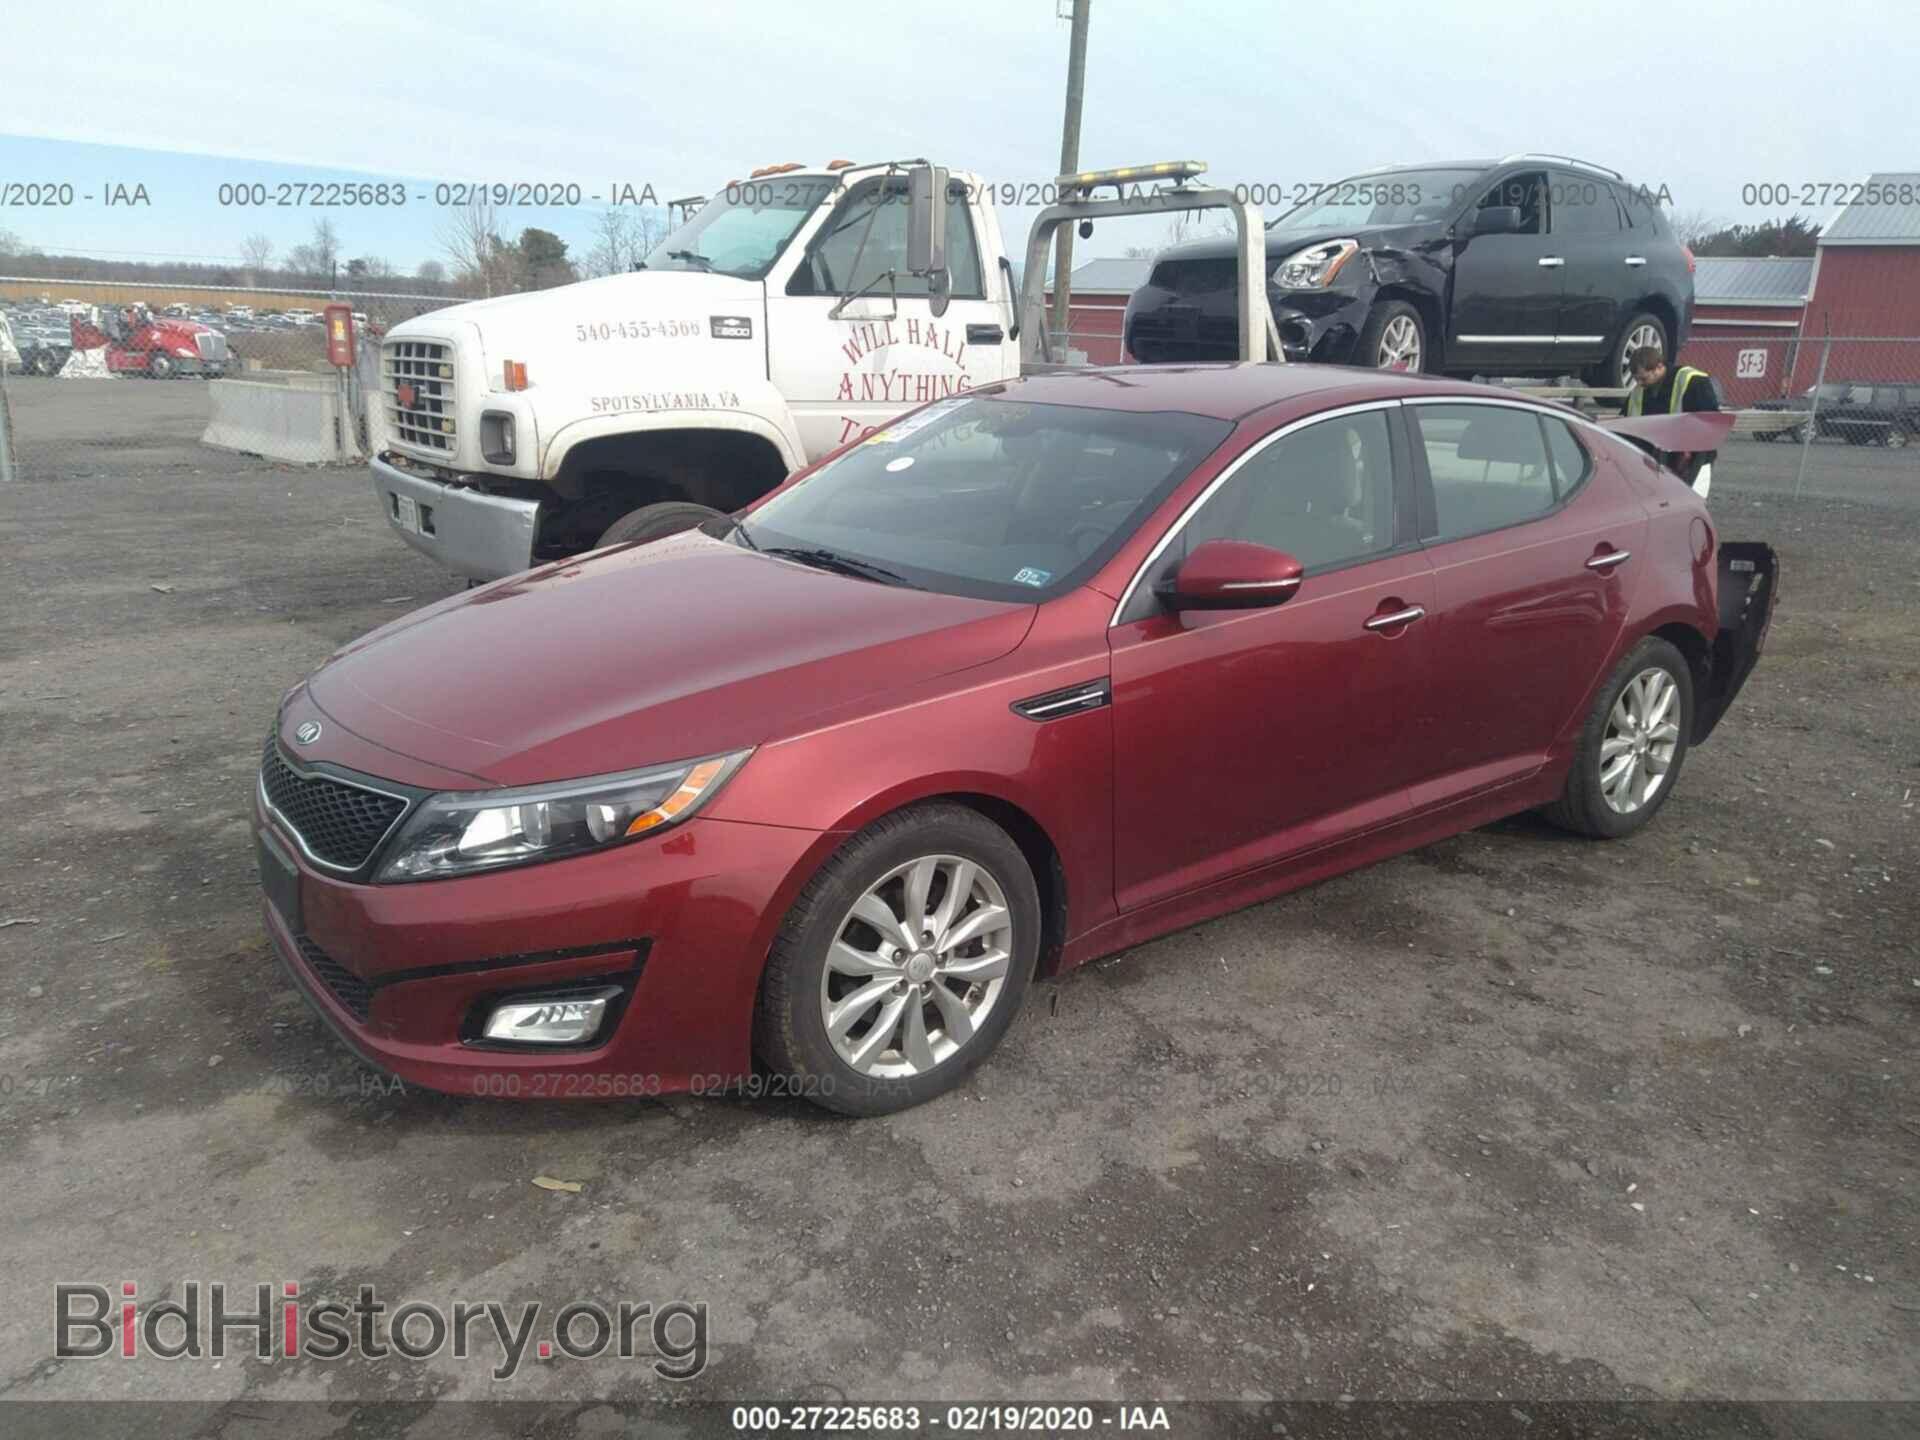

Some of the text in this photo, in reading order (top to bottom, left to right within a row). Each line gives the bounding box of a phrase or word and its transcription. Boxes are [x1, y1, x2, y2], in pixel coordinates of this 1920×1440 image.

[841, 318, 966, 371] WILL HALL
[1739, 352, 1766, 374] SF-3
[836, 367, 972, 402] ANYTHING
